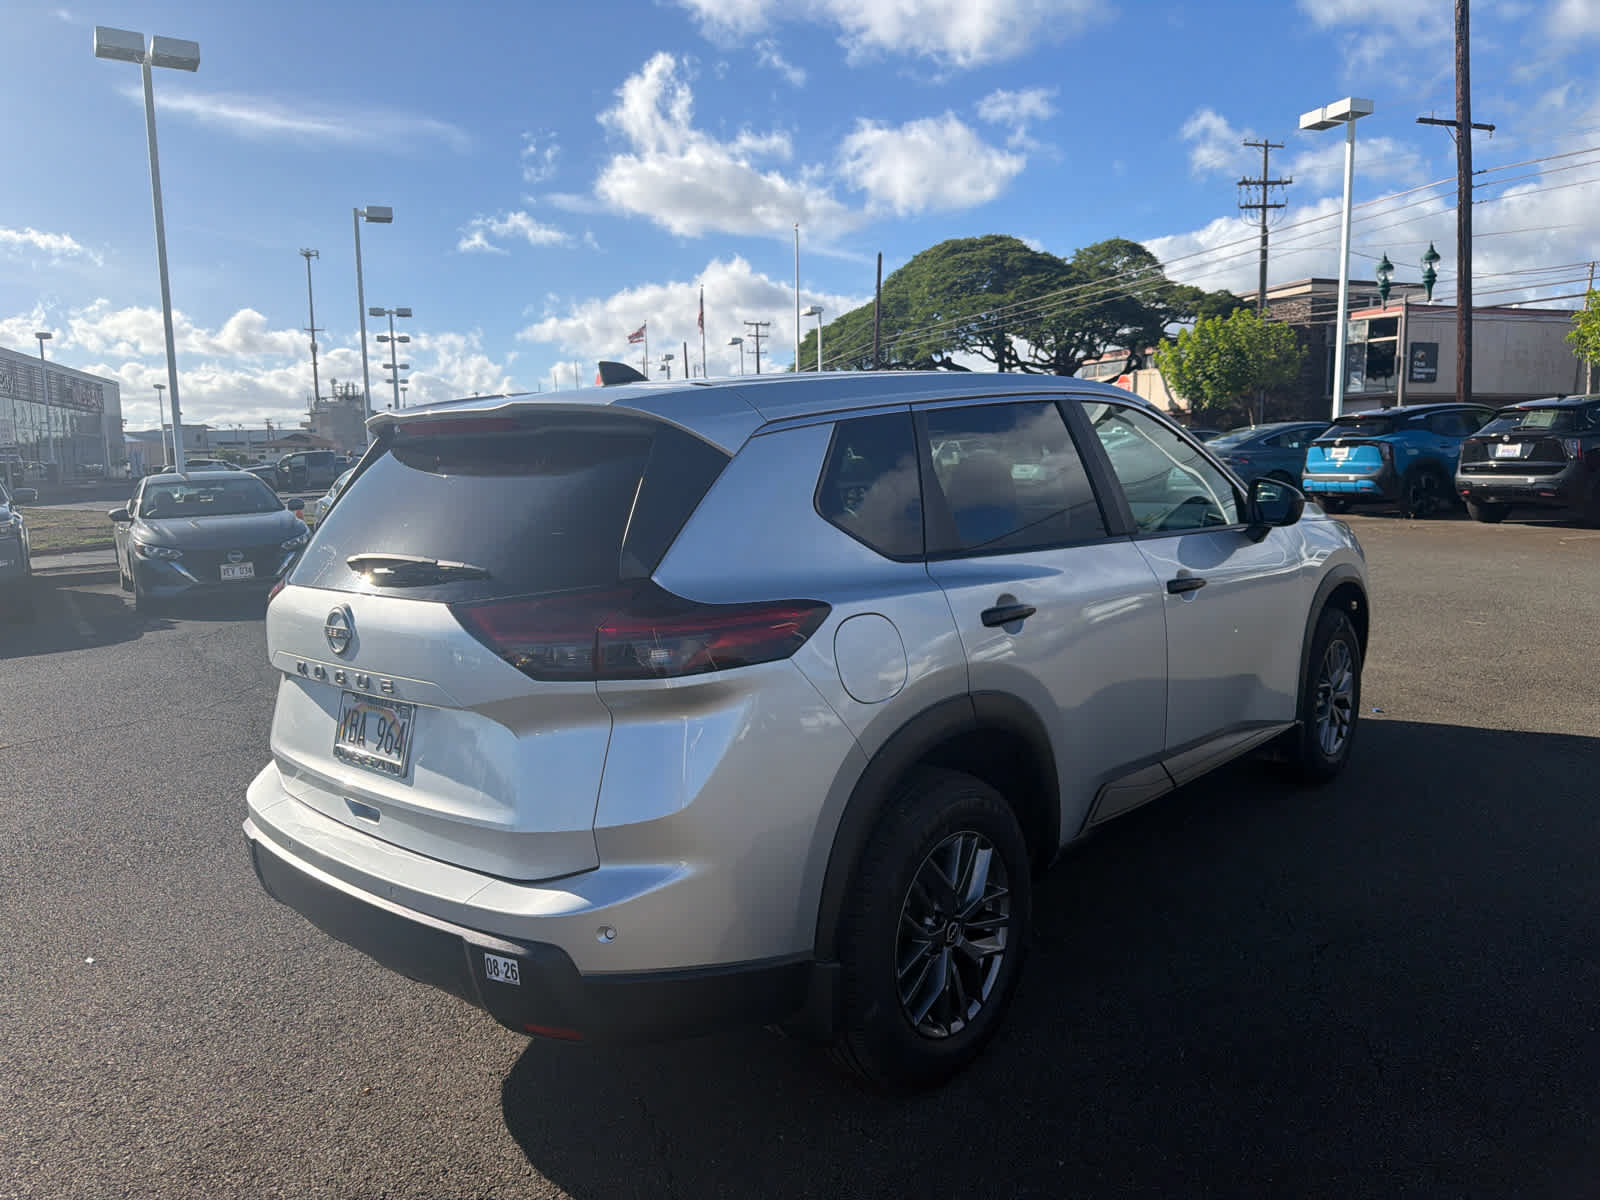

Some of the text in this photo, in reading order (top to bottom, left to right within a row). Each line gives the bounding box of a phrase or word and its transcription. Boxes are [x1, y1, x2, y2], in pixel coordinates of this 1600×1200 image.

[296, 660, 394, 694] ROGUE
[342, 706, 366, 746] YBA
[376, 717, 406, 759] 964
